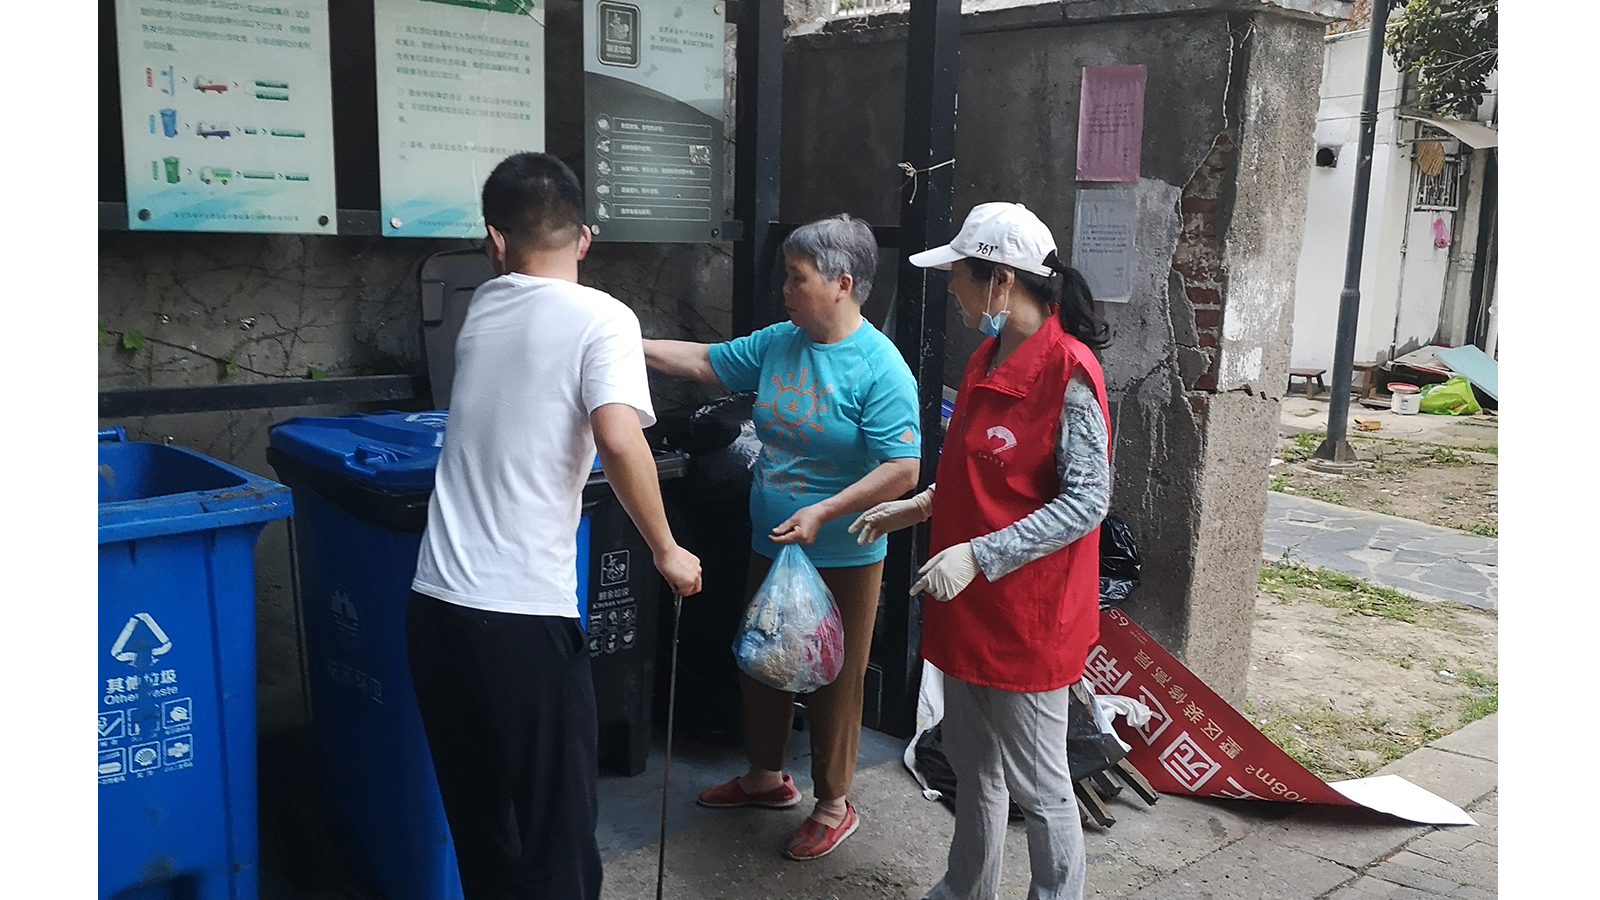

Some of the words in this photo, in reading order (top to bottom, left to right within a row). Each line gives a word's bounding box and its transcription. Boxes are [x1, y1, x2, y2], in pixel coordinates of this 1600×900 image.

[975, 242, 999, 257] 361°
[1133, 648, 1243, 759] 墅区装修高层
